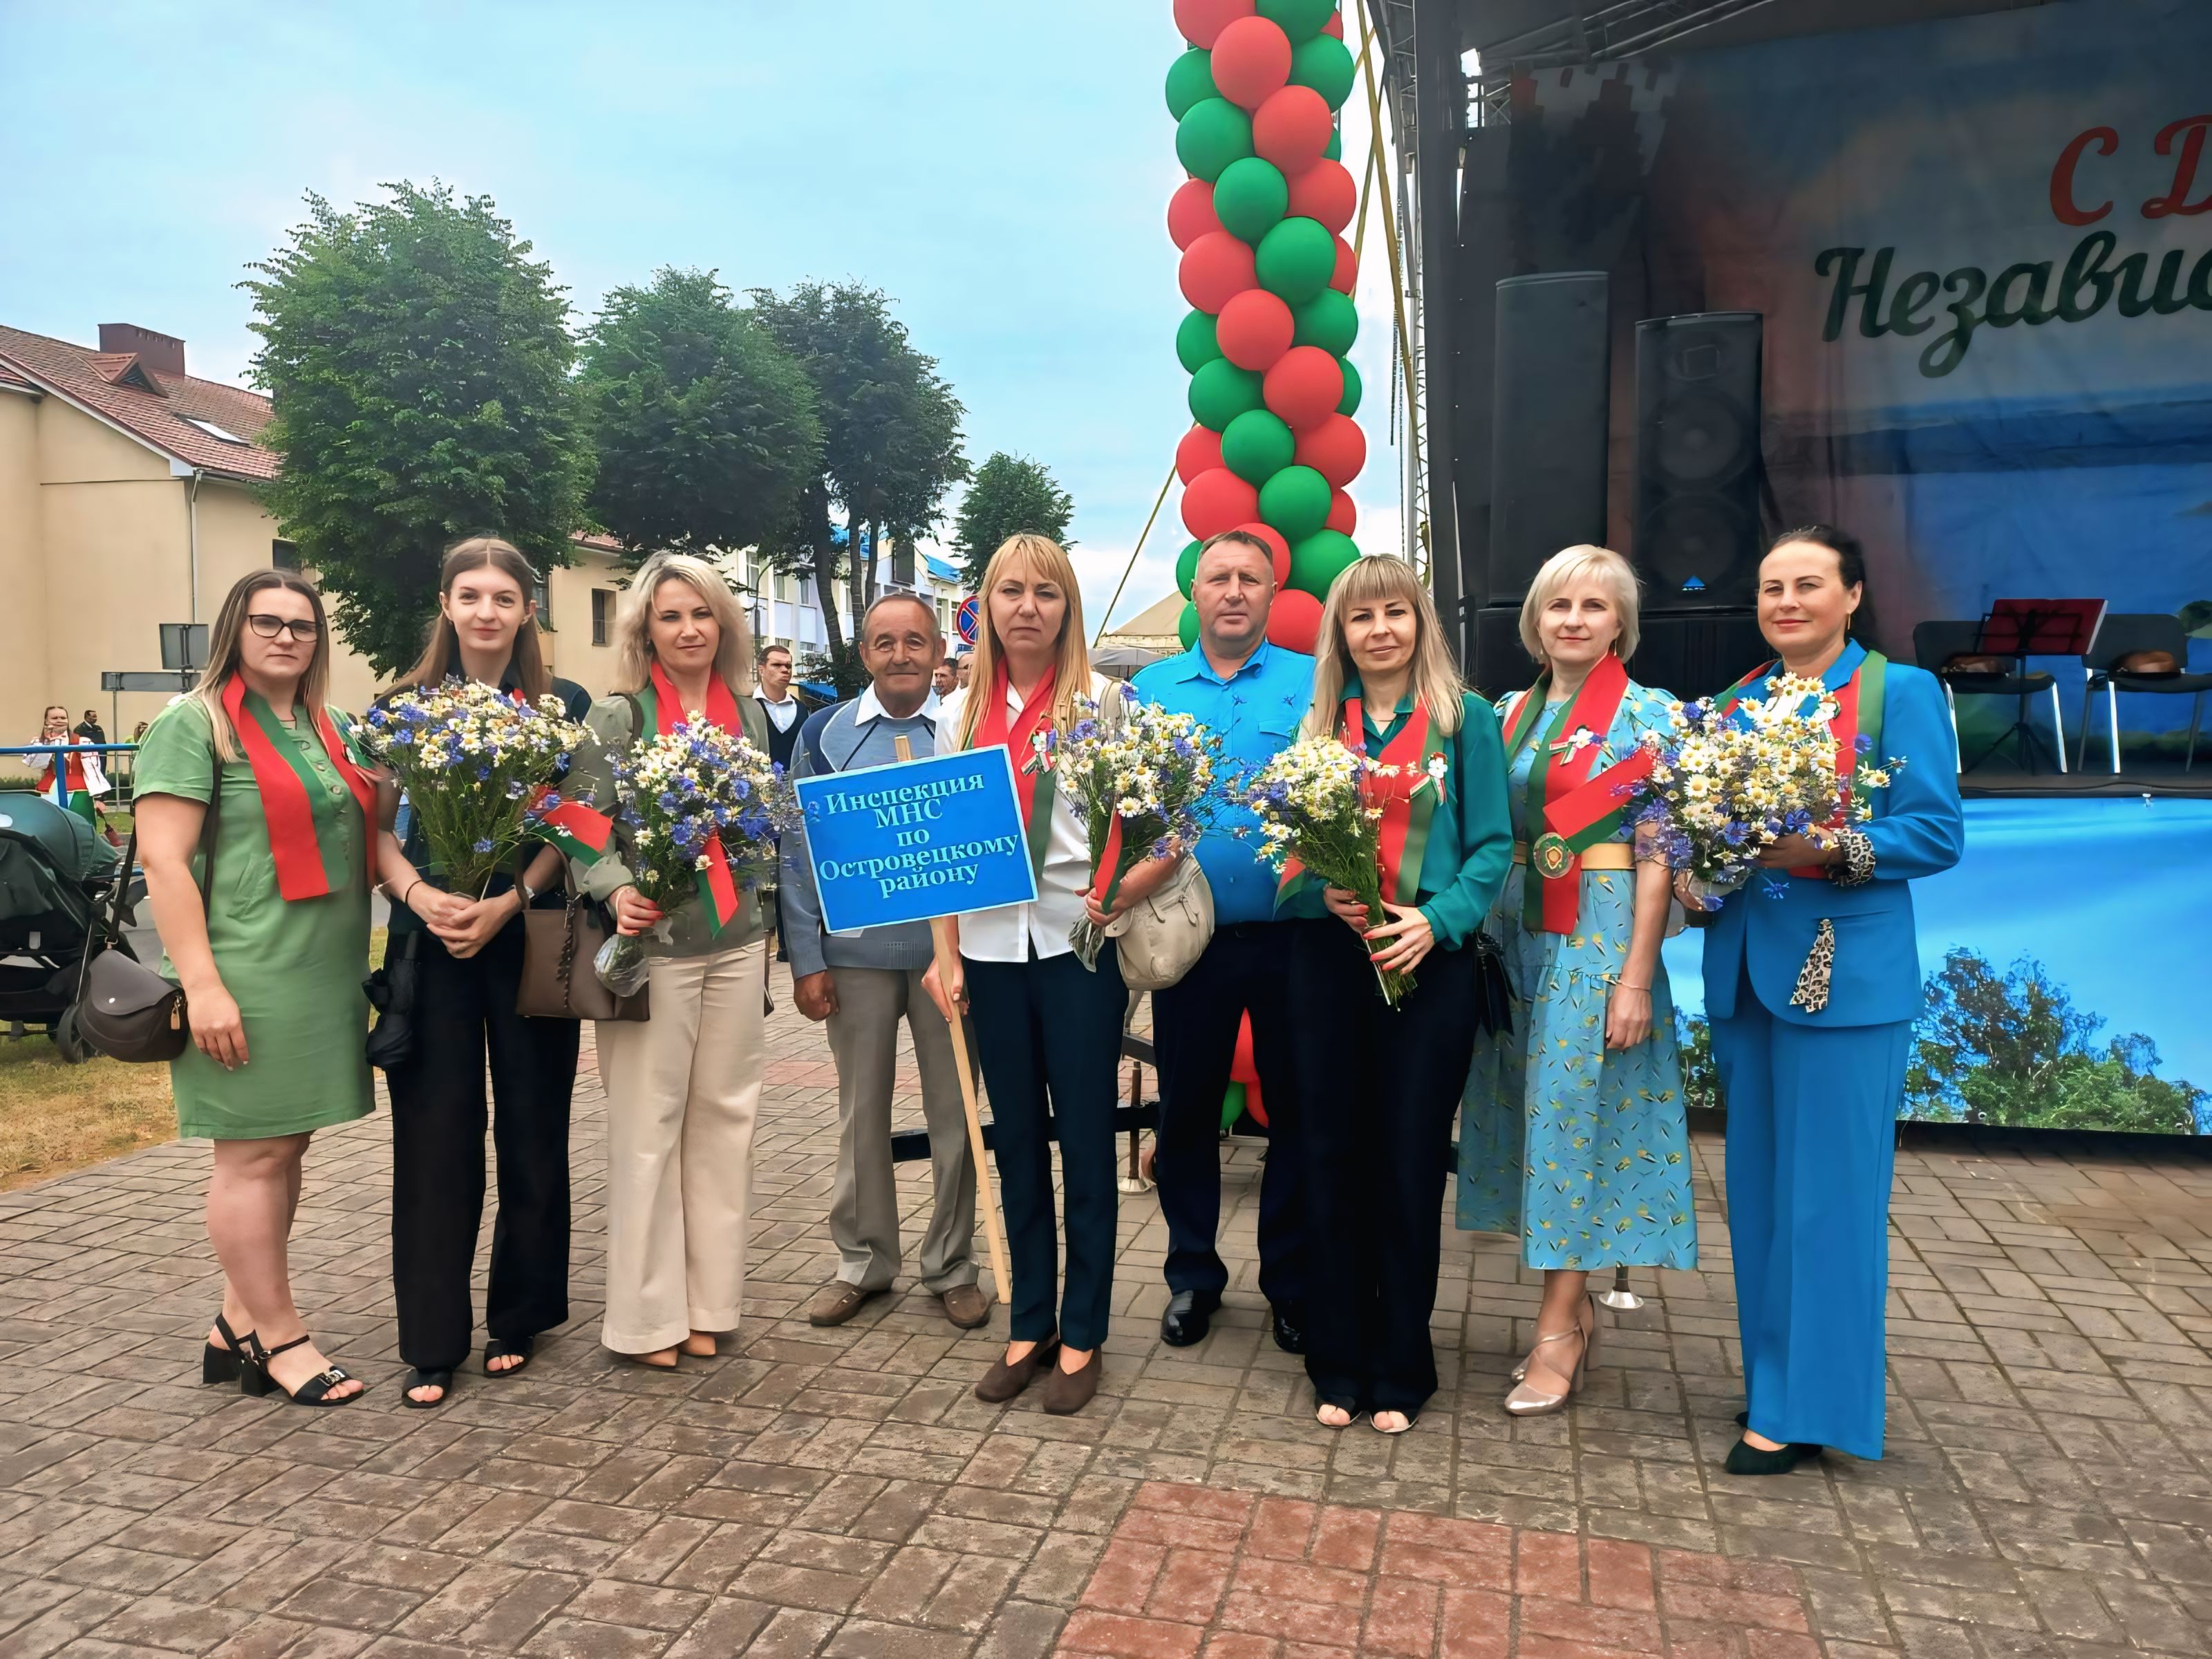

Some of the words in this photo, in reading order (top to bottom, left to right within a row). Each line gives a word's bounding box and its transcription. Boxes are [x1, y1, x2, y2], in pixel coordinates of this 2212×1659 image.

[2050, 126, 2119, 226] С
[825, 774, 984, 814] Инспекция
[874, 798, 943, 828] МНС
[897, 829, 930, 847] по
[819, 834, 1018, 881] Островецкому
[879, 864, 979, 899] району
